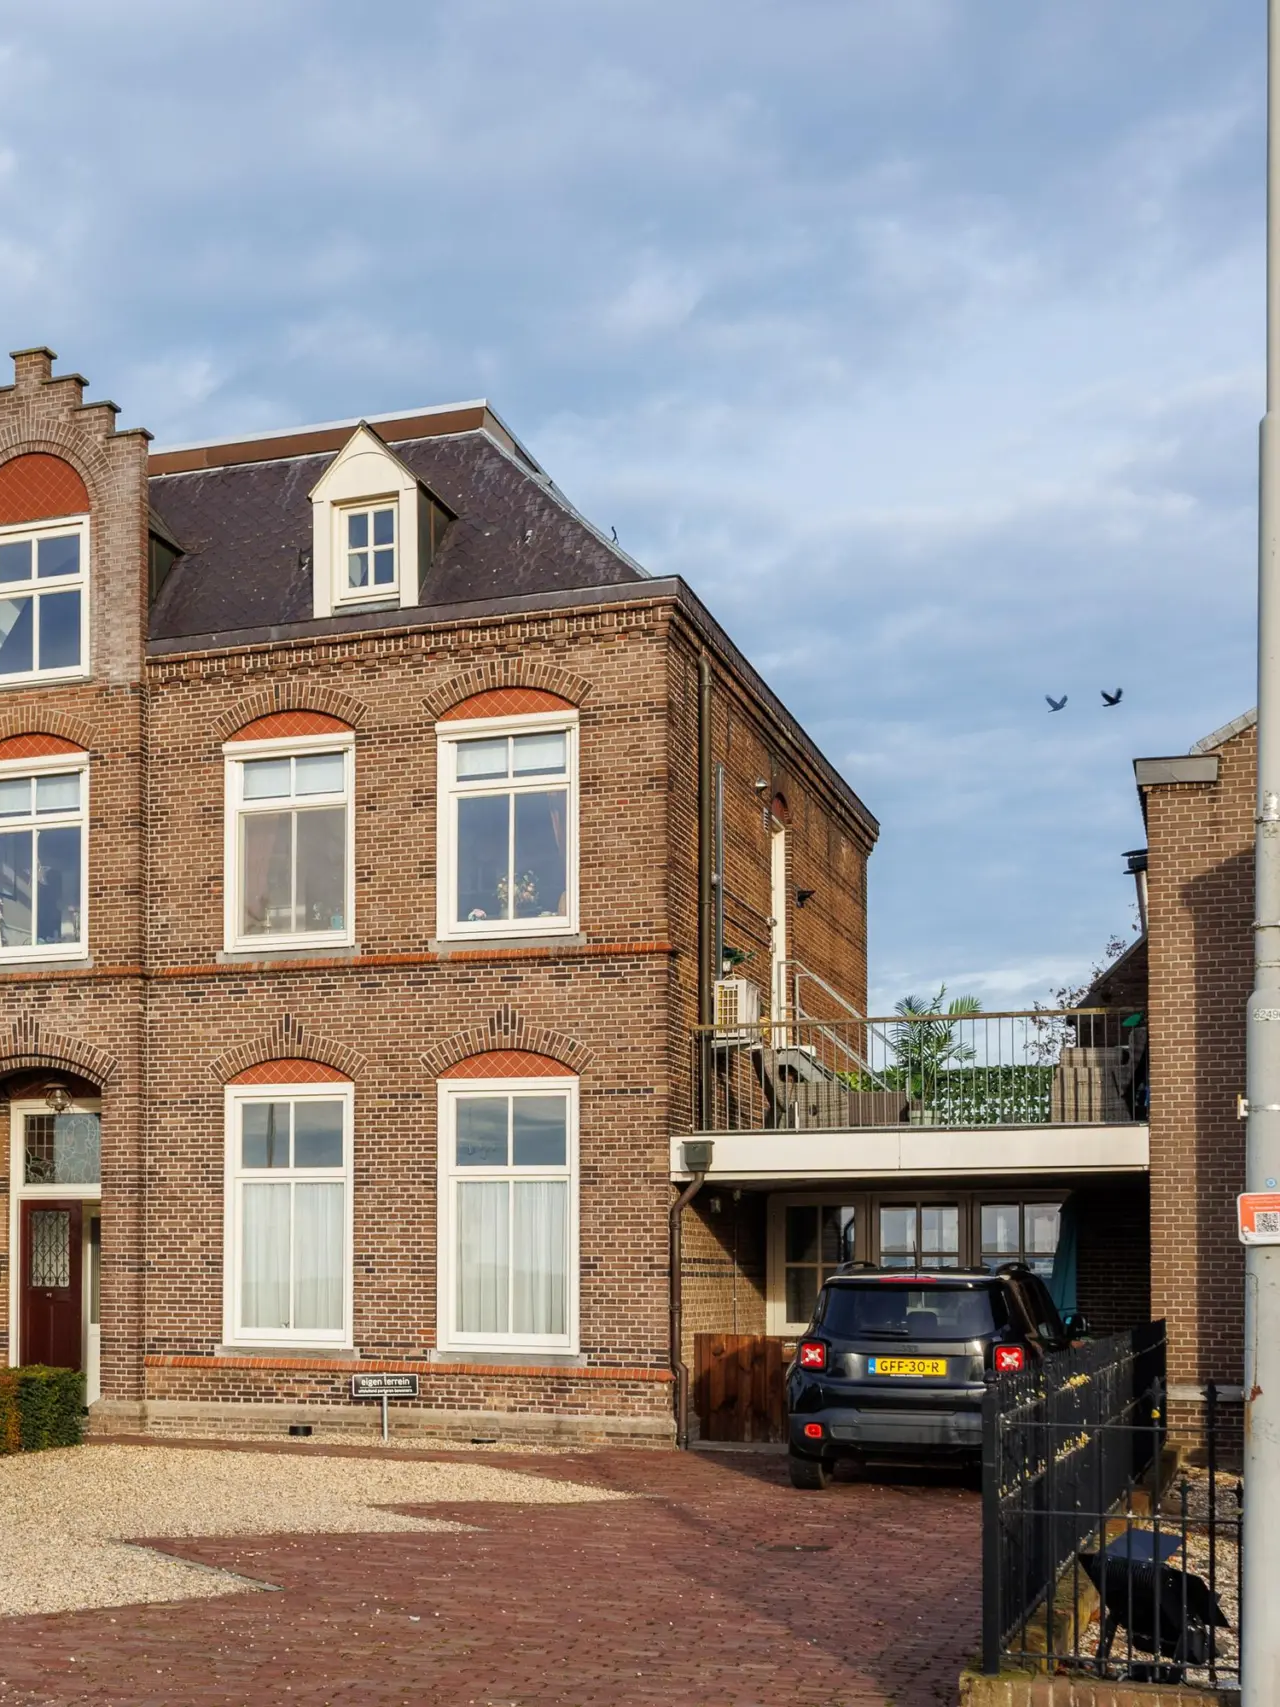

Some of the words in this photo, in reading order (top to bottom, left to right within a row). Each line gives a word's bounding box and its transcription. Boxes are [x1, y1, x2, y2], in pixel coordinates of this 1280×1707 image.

[1254, 1009, 1280, 1019] 6249
[880, 1360, 939, 1373] GFF-30-R
[361, 1377, 383, 1387] eigen
[384, 1376, 410, 1386] terrein
